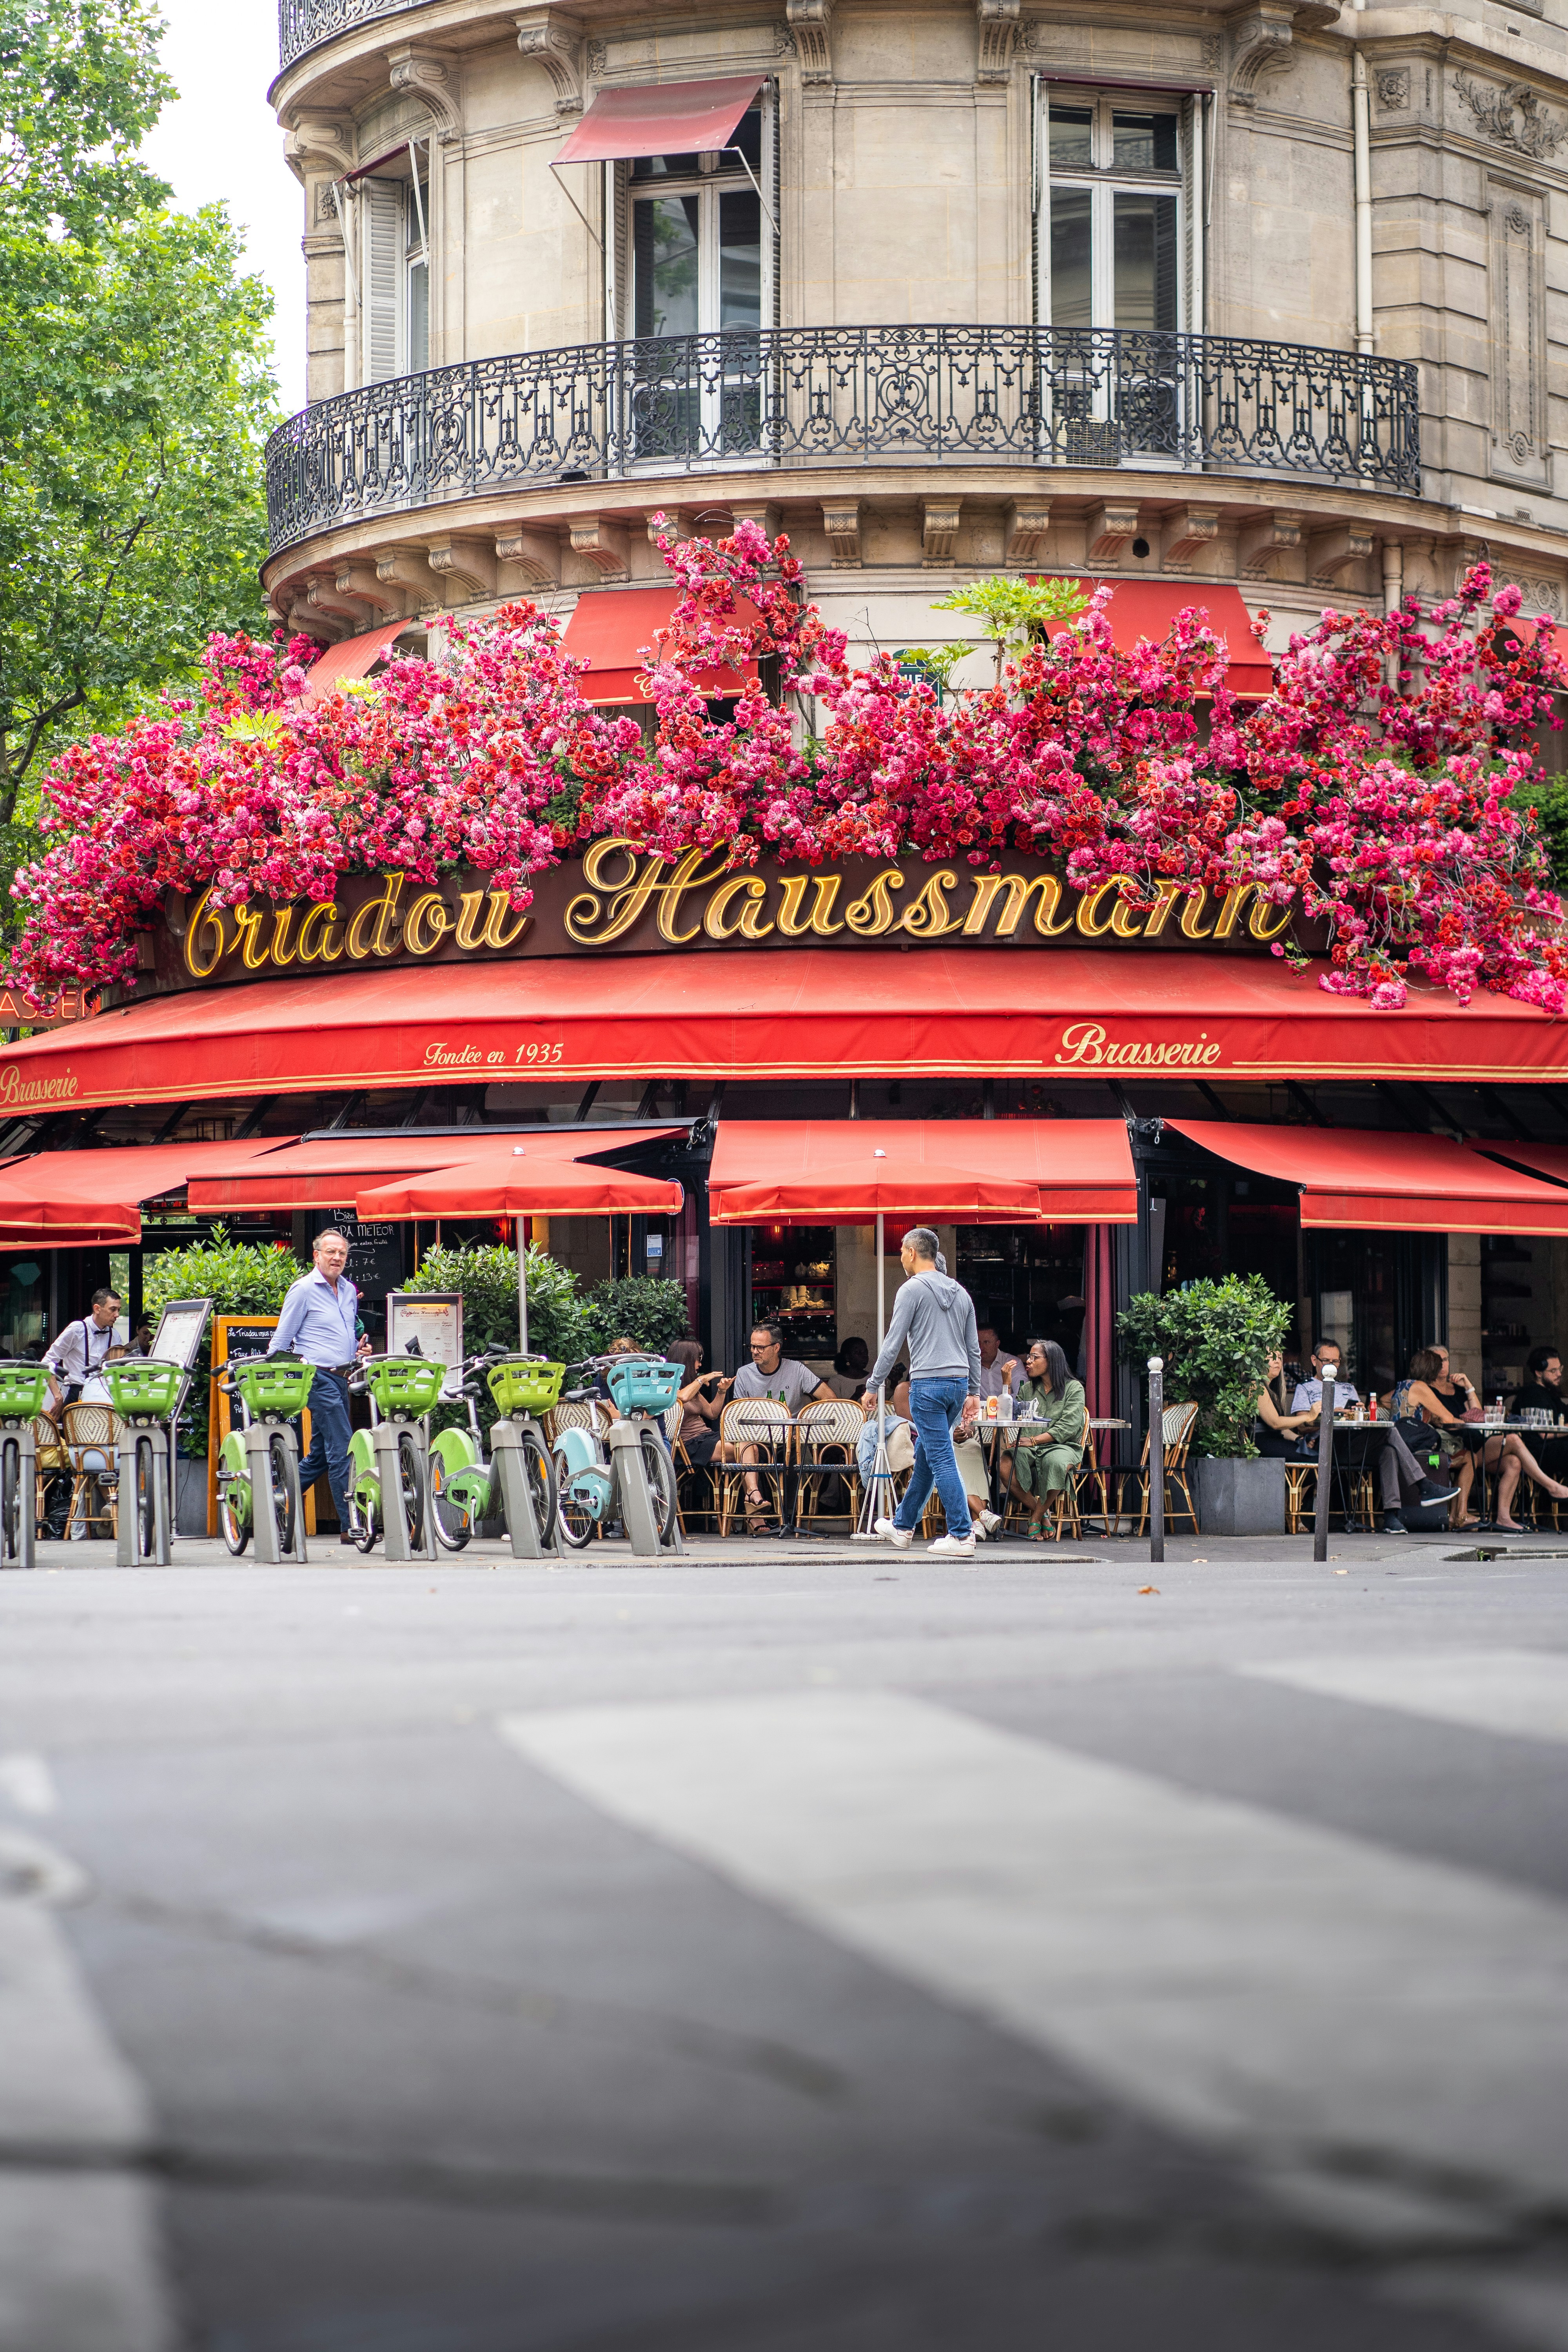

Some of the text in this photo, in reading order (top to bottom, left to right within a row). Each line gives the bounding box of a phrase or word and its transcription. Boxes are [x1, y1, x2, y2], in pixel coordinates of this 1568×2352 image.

[423, 1042, 564, 1065] Fondée en 1935
[1054, 1022, 1221, 1065] Brasserie
[0, 1064, 78, 1105] Brasserie
[357, 1223, 394, 1237] METEOR
[233, 1348, 248, 1357] Faux
